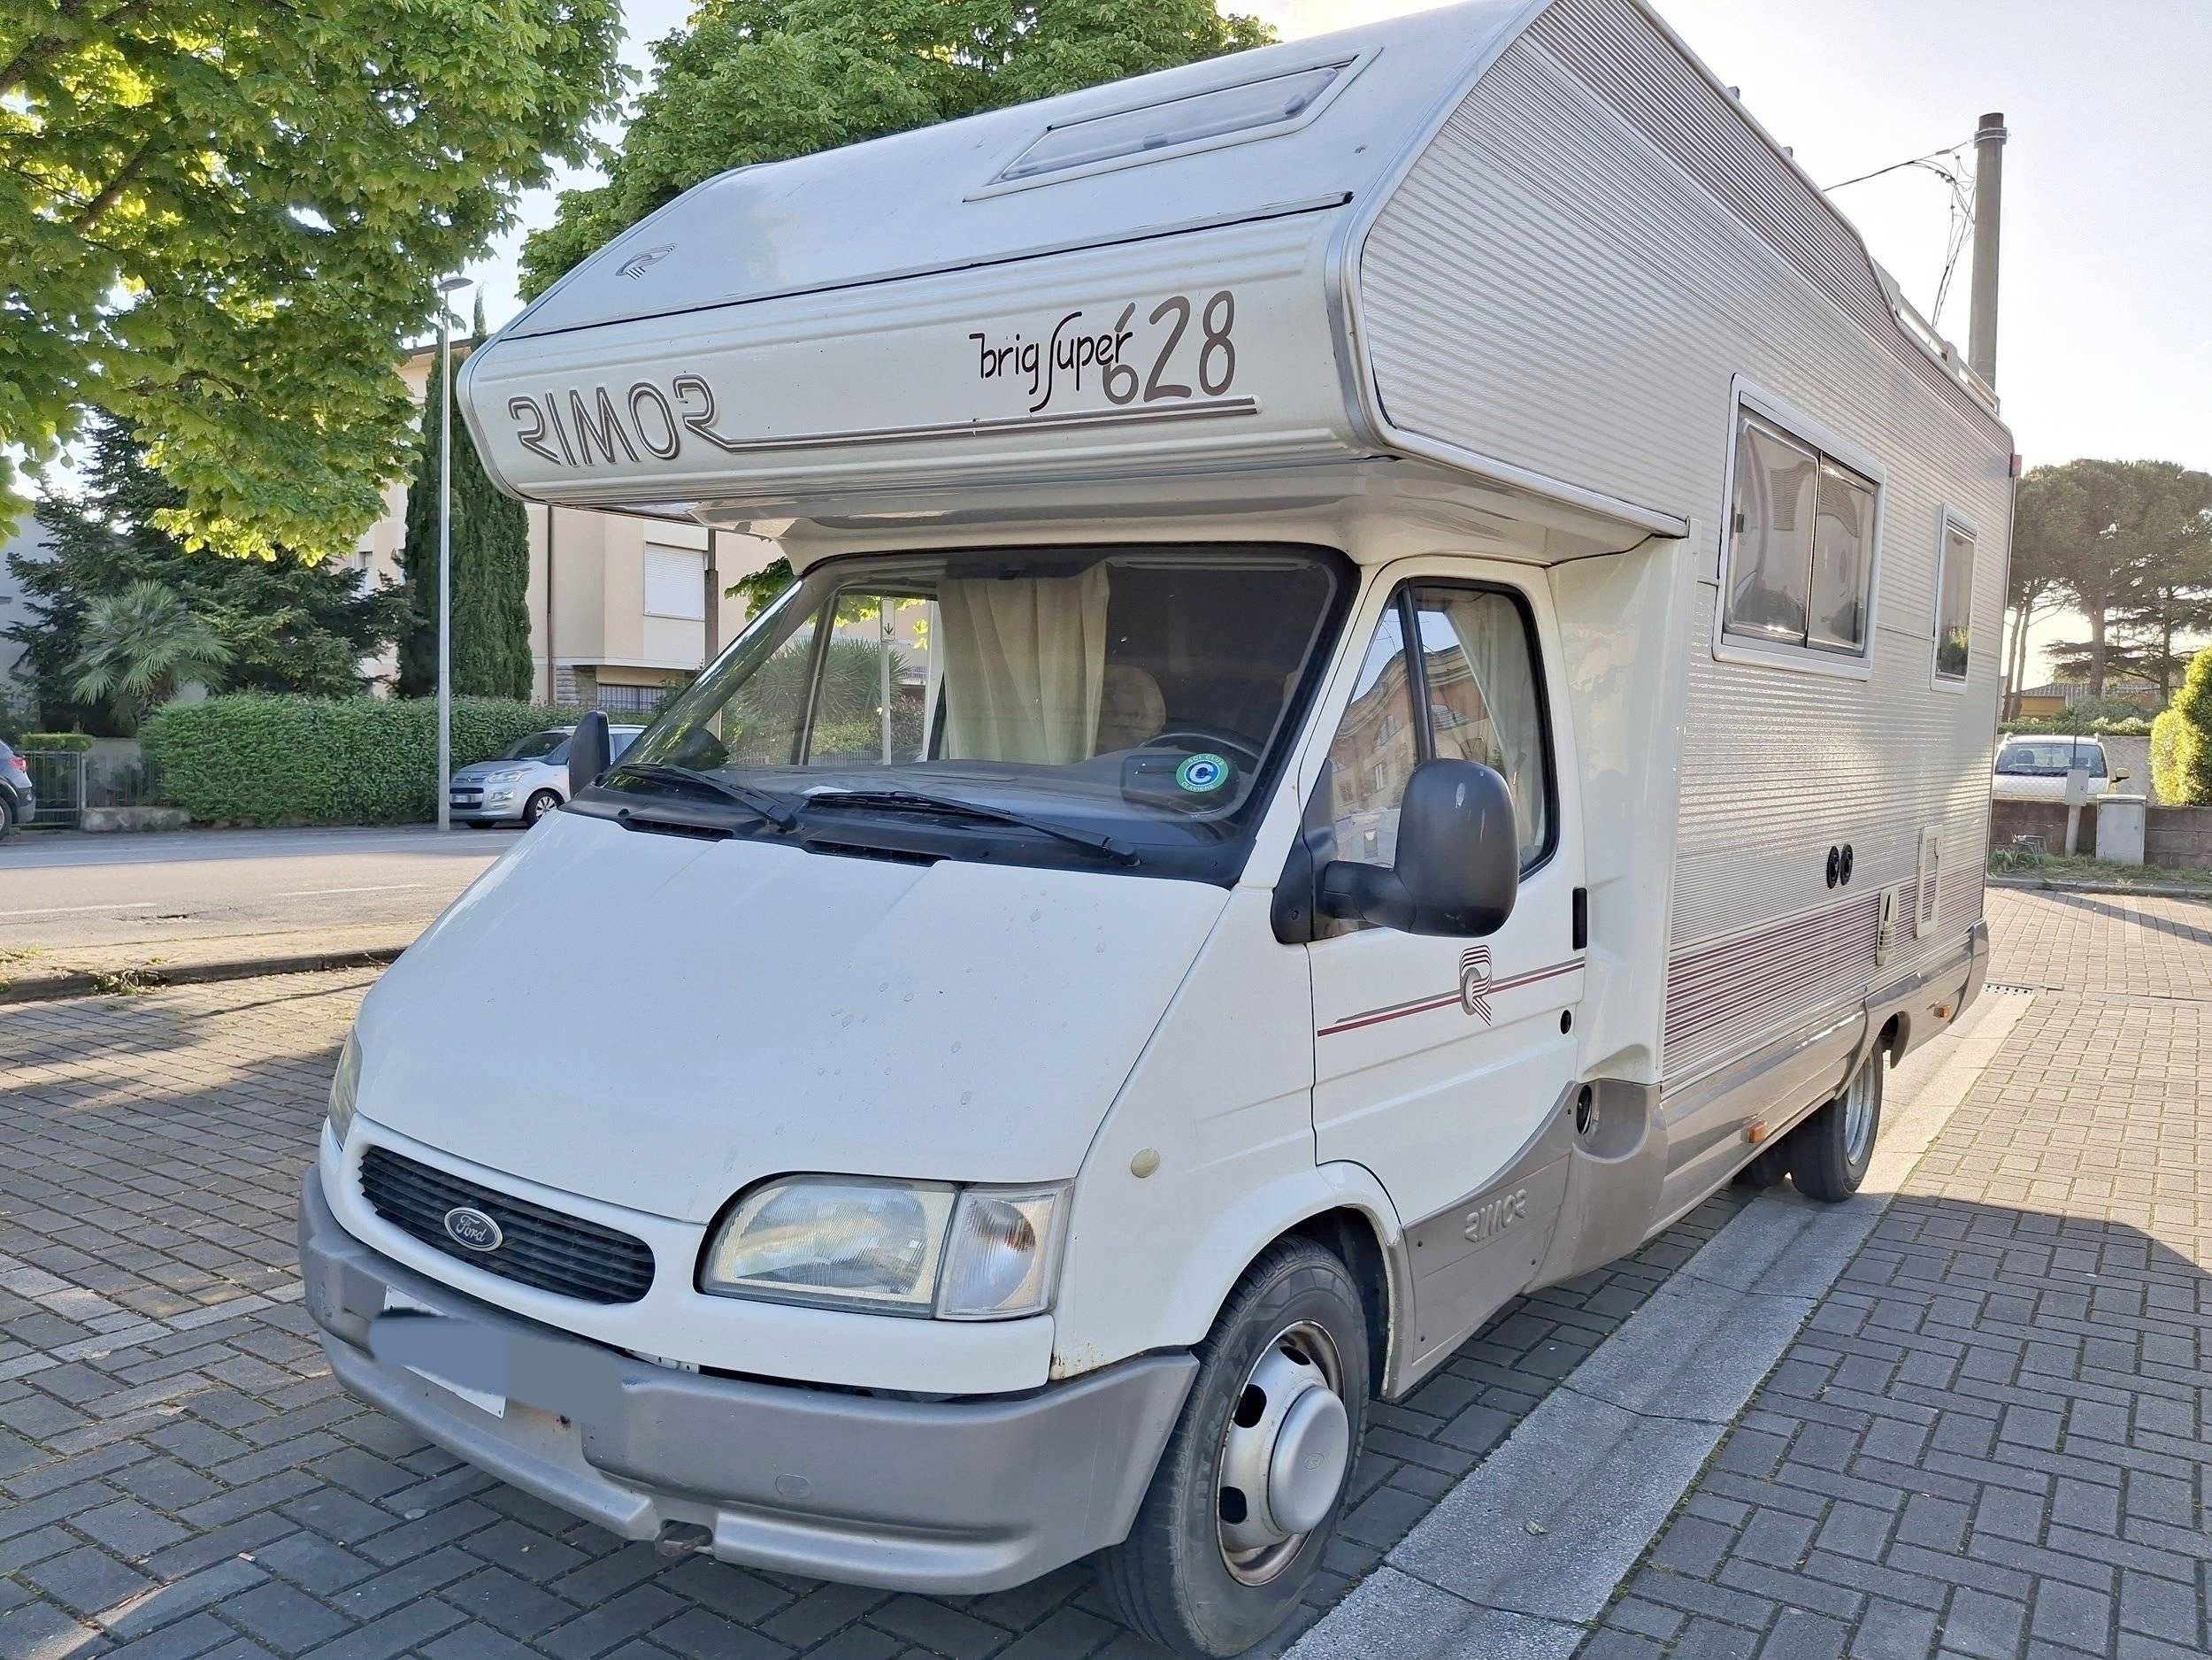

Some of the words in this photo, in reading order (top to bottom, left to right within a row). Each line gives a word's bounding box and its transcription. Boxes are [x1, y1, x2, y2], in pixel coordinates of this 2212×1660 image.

[1102, 290, 1236, 405] 628
[508, 373, 729, 467] RIMOR
[456, 1215, 487, 1242] Ford
